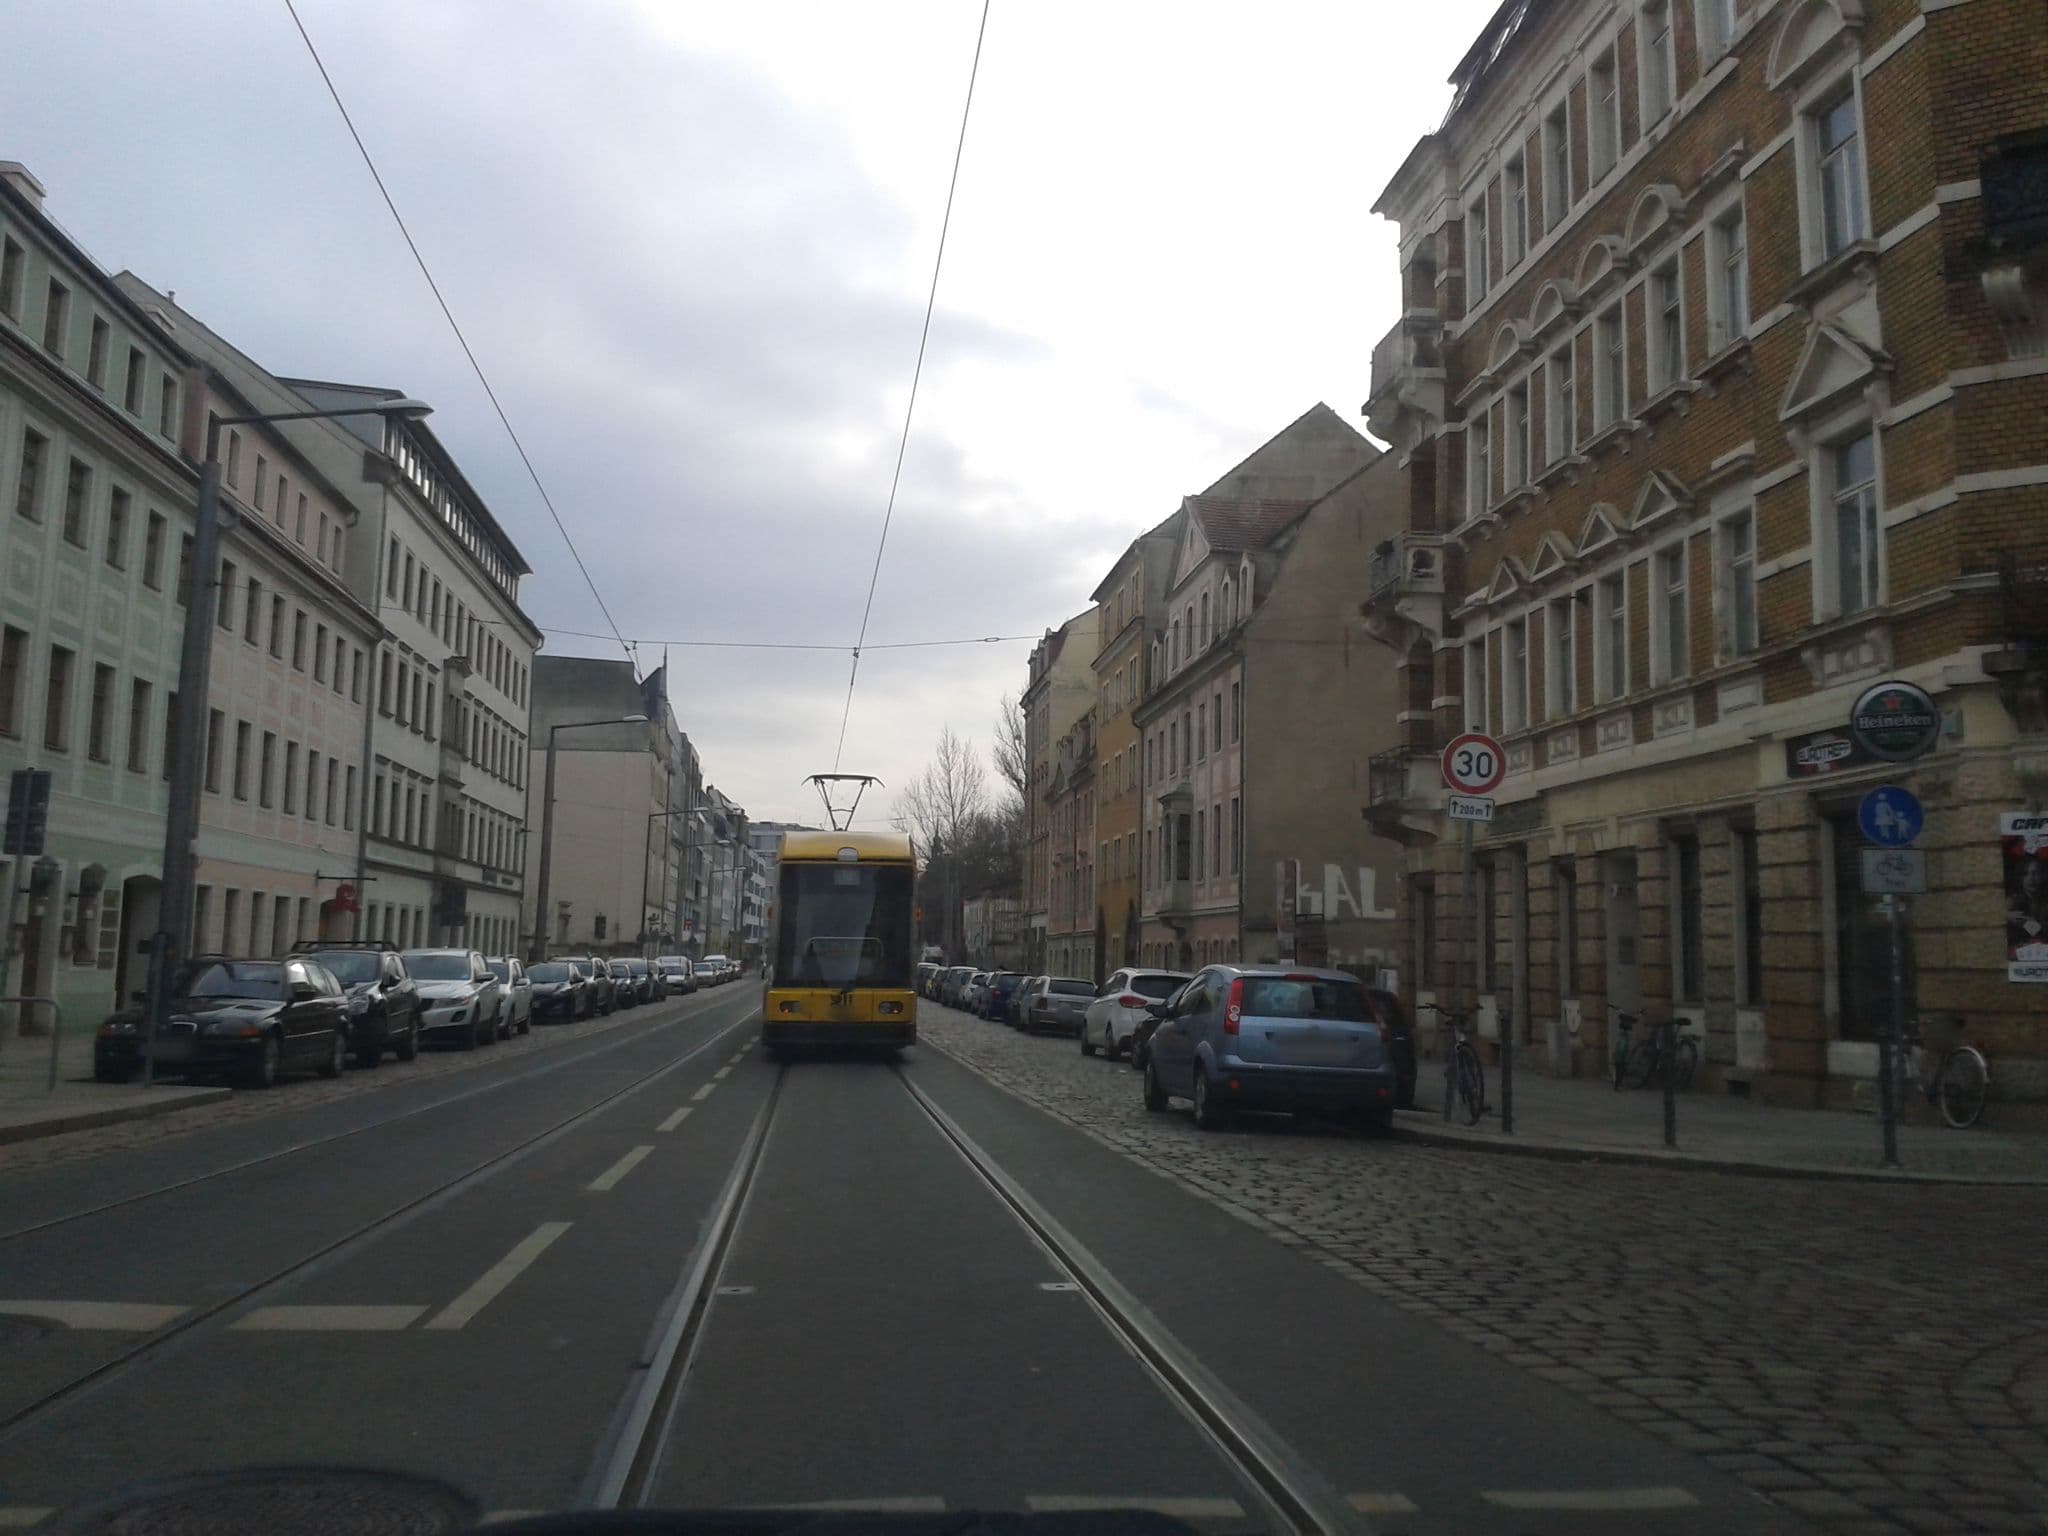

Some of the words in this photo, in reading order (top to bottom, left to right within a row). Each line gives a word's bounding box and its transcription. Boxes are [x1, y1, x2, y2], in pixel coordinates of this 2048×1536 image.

[1859, 713, 1931, 730] Heineken
[1457, 750, 1492, 778] 30
[1460, 804, 1475, 815] 200
